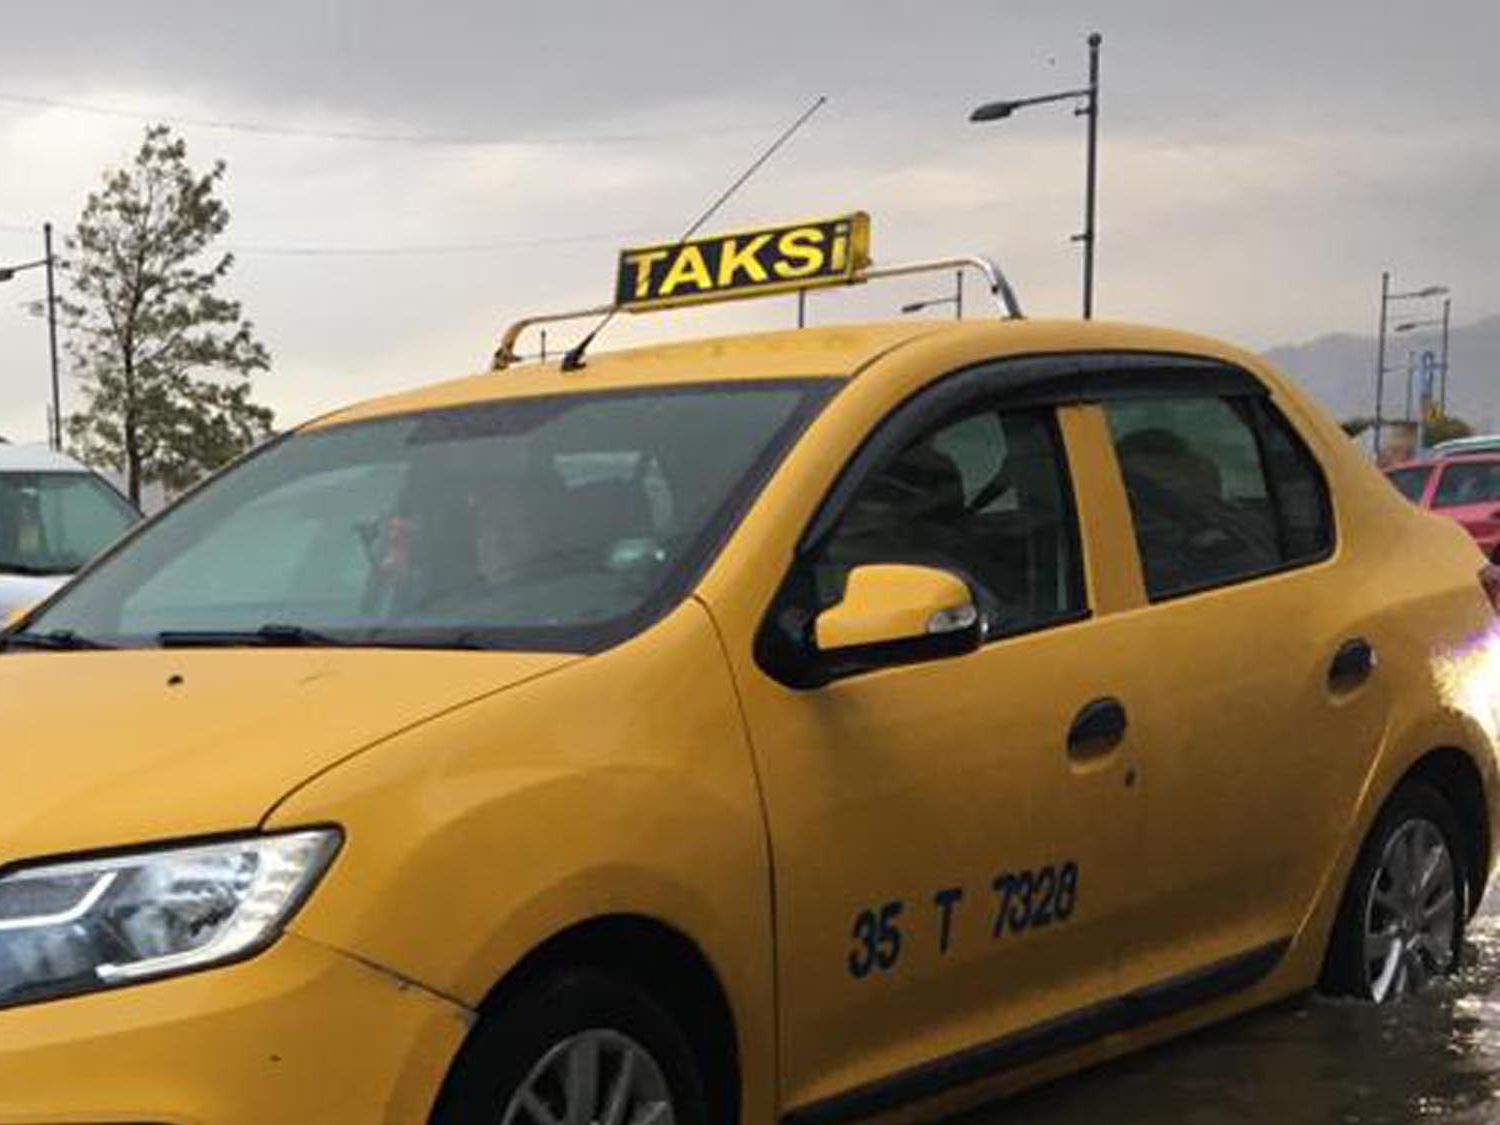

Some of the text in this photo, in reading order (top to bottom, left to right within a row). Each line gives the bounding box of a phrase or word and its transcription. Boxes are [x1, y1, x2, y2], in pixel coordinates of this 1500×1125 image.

[848, 860, 1079, 979] 35 T 7328
